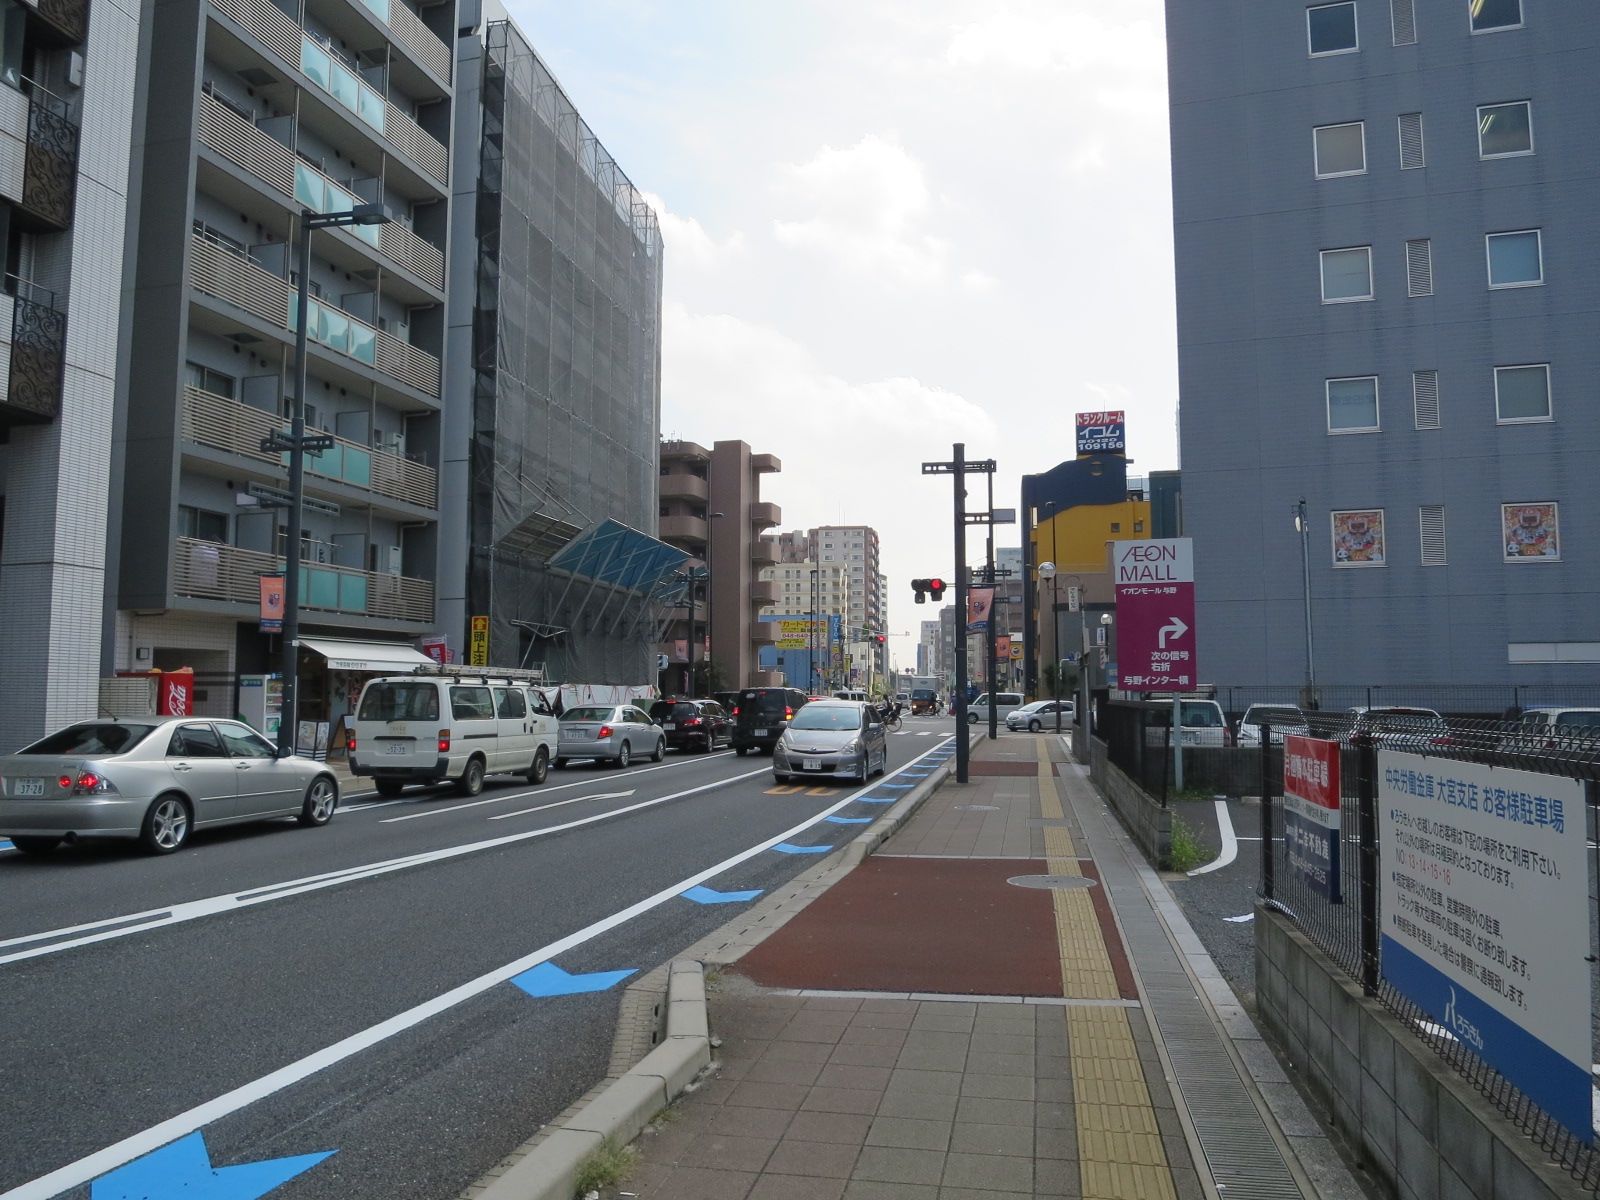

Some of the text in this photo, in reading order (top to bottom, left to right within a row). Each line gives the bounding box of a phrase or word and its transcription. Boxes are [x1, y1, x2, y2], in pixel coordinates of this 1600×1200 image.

[1076, 412, 1124, 426] トランクルーム
[1079, 425, 1120, 438] イコム
[1078, 442, 1124, 451] 109156
[1120, 564, 1178, 582] MALL
[1121, 586, 1177, 595] イオンモール 与野
[473, 631, 485, 666] 頭上注
[1151, 651, 1189, 661] 次の信号
[1151, 662, 1171, 672] 右折
[1123, 675, 1189, 686] 与野インター横
[1385, 766, 1565, 834] 中央労働金庫 大宮支店 お客様駐車場
